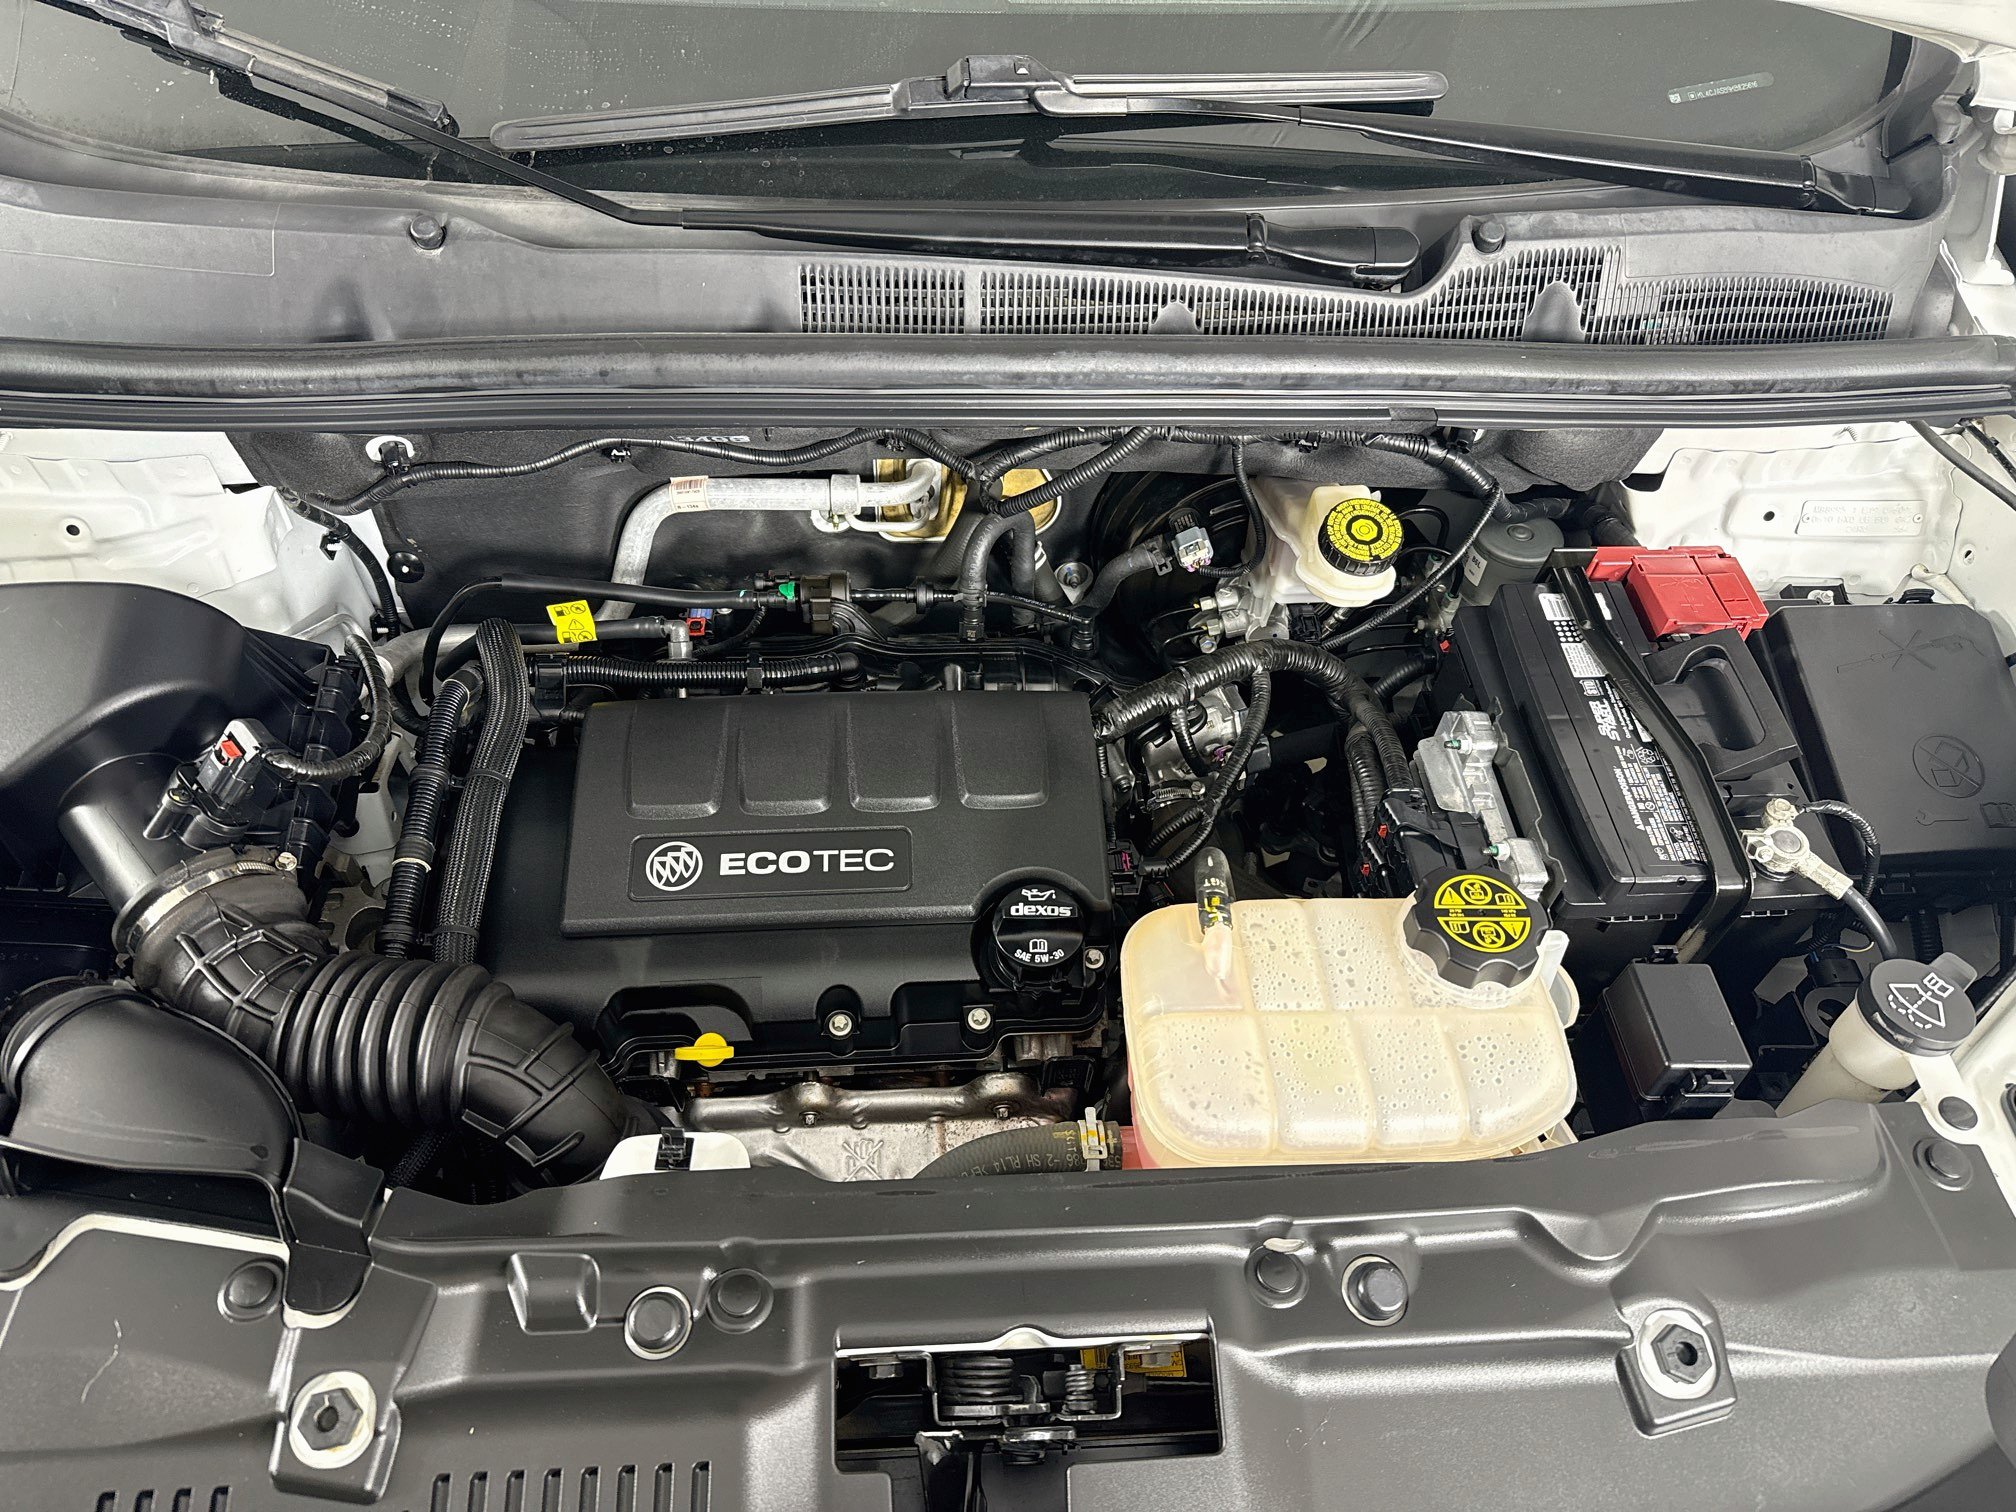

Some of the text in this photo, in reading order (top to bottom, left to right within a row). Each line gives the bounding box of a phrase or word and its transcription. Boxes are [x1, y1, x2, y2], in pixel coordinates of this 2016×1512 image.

[1588, 701, 1607, 734] SUPER
[1596, 698, 1621, 740] START
[719, 848, 895, 876] ECOTEC
[1010, 902, 1072, 917] dexos
[1014, 949, 1064, 963] SAE 5W-30
